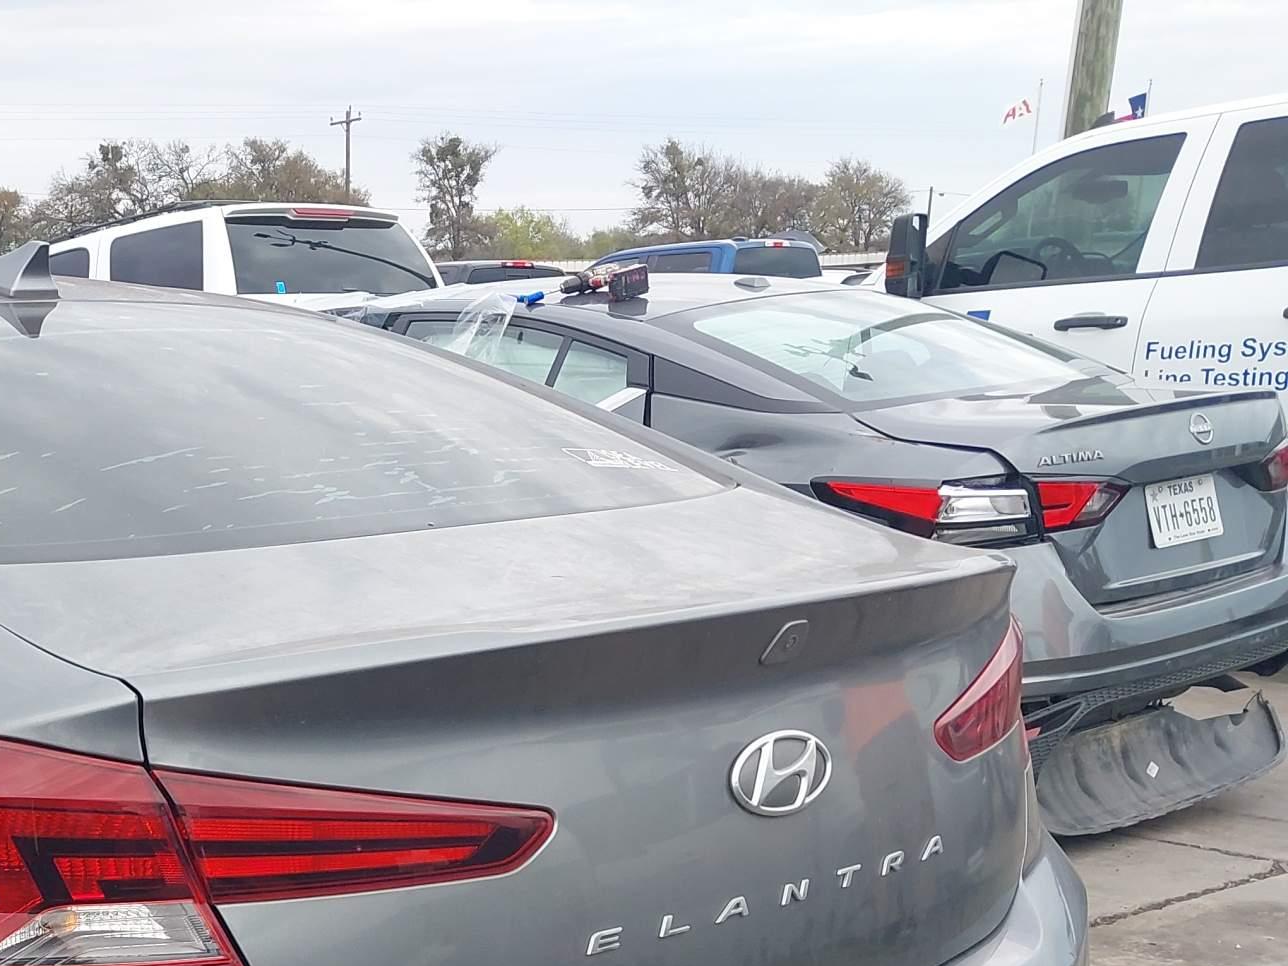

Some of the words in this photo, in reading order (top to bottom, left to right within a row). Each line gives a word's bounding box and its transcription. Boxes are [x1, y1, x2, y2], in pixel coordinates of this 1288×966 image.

[1145, 340, 1232, 363] Fueling
[1241, 338, 1288, 362] Sys
[1201, 367, 1288, 391] Testing
[1038, 449, 1104, 467] ALTIMA
[1167, 481, 1194, 496] TEXAS
[586, 834, 945, 956] ELANTRA
